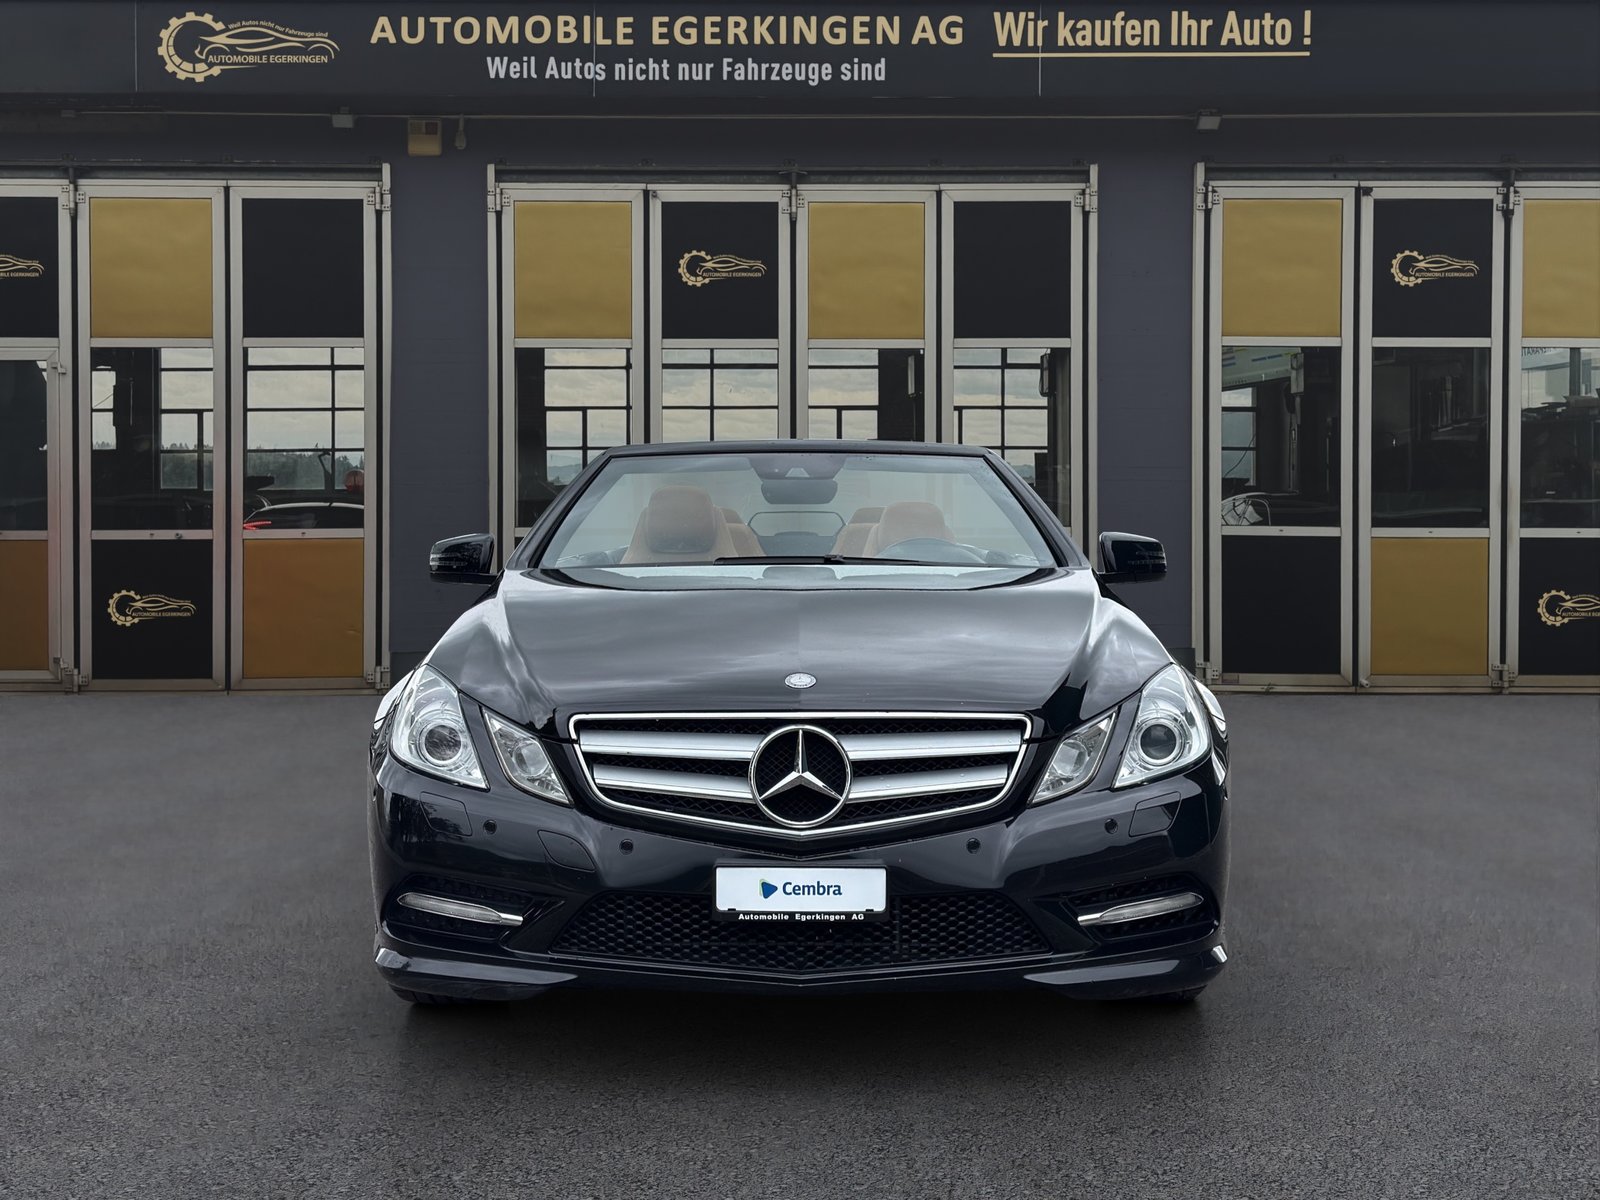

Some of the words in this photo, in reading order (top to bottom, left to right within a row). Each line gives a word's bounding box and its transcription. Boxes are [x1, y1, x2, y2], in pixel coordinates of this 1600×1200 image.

[228, 21, 241, 30] Weil
[259, 20, 275, 29] nicht
[274, 24, 285, 32] nur
[284, 27, 315, 38] Fahrzeuge
[370, 15, 634, 46] AUTOMOBILE
[651, 15, 900, 46] EGERKINGEN
[911, 15, 964, 46] AG
[993, 11, 1049, 47] Wir
[1057, 11, 1161, 46] kaufen
[1170, 11, 1214, 46] Ihr
[1220, 10, 1292, 46] Auto
[207, 54, 268, 64] AUTOMOBILE
[269, 54, 328, 64] EGERKINGEN
[486, 56, 538, 80] Weil
[544, 56, 606, 81] Autos
[614, 57, 670, 81] nicht
[677, 60, 715, 82] nur
[722, 58, 833, 86] Fahrzeuge
[840, 58, 886, 82] sind
[782, 881, 843, 896] Cembra
[795, 913, 846, 922] Egerkingen
